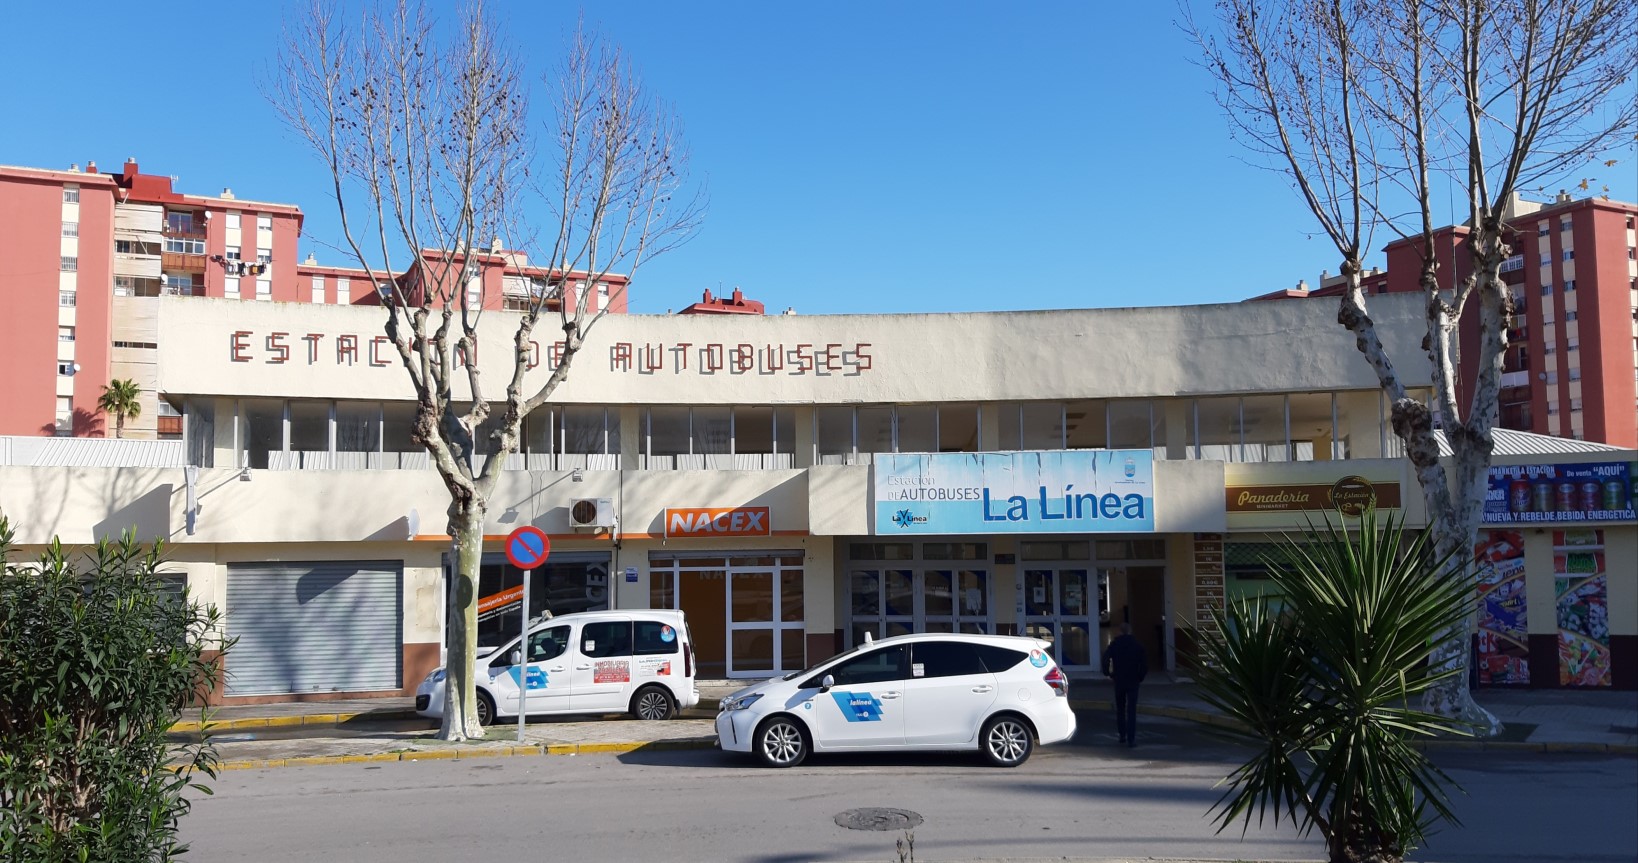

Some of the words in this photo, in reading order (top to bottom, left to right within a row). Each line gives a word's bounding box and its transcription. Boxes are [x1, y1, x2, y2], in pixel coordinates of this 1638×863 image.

[615, 342, 872, 371] AUTOBUSES
[887, 474, 935, 486] Estación
[983, 488, 1028, 521] La
[1040, 484, 1145, 520] Línea
[670, 511, 765, 533] NACEX
[1557, 510, 1585, 522] BEBIDA
